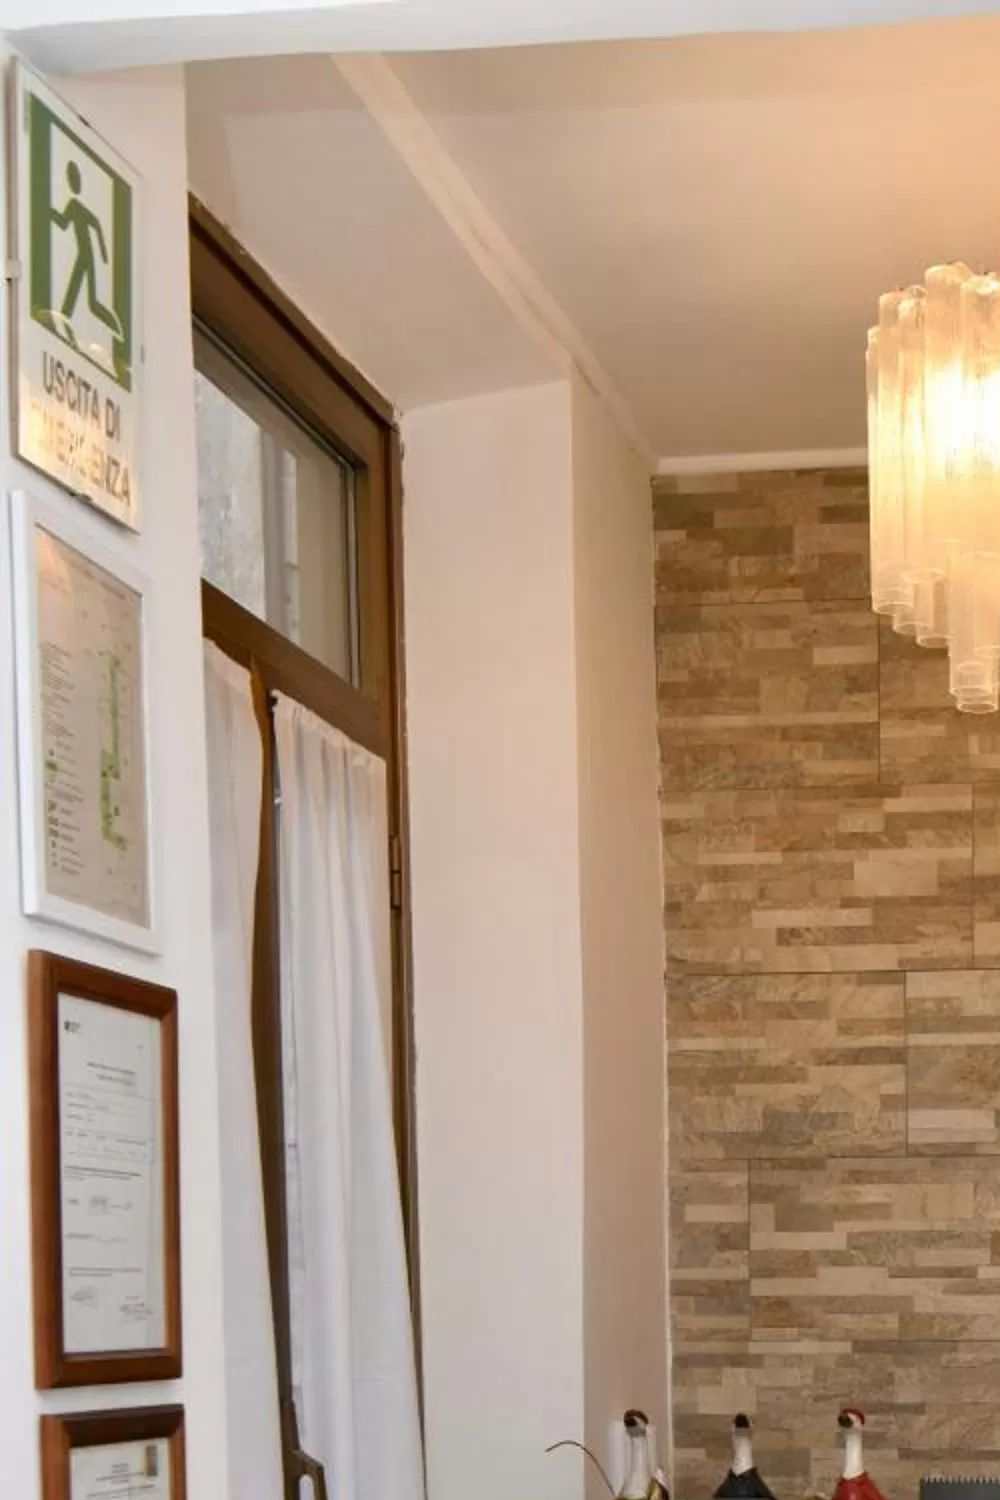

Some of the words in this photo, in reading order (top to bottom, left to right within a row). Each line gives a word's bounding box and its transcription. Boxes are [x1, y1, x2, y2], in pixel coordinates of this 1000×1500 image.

[43, 351, 100, 430] USCITA
[105, 396, 121, 442] DI
[30, 398, 131, 507] EENZA
